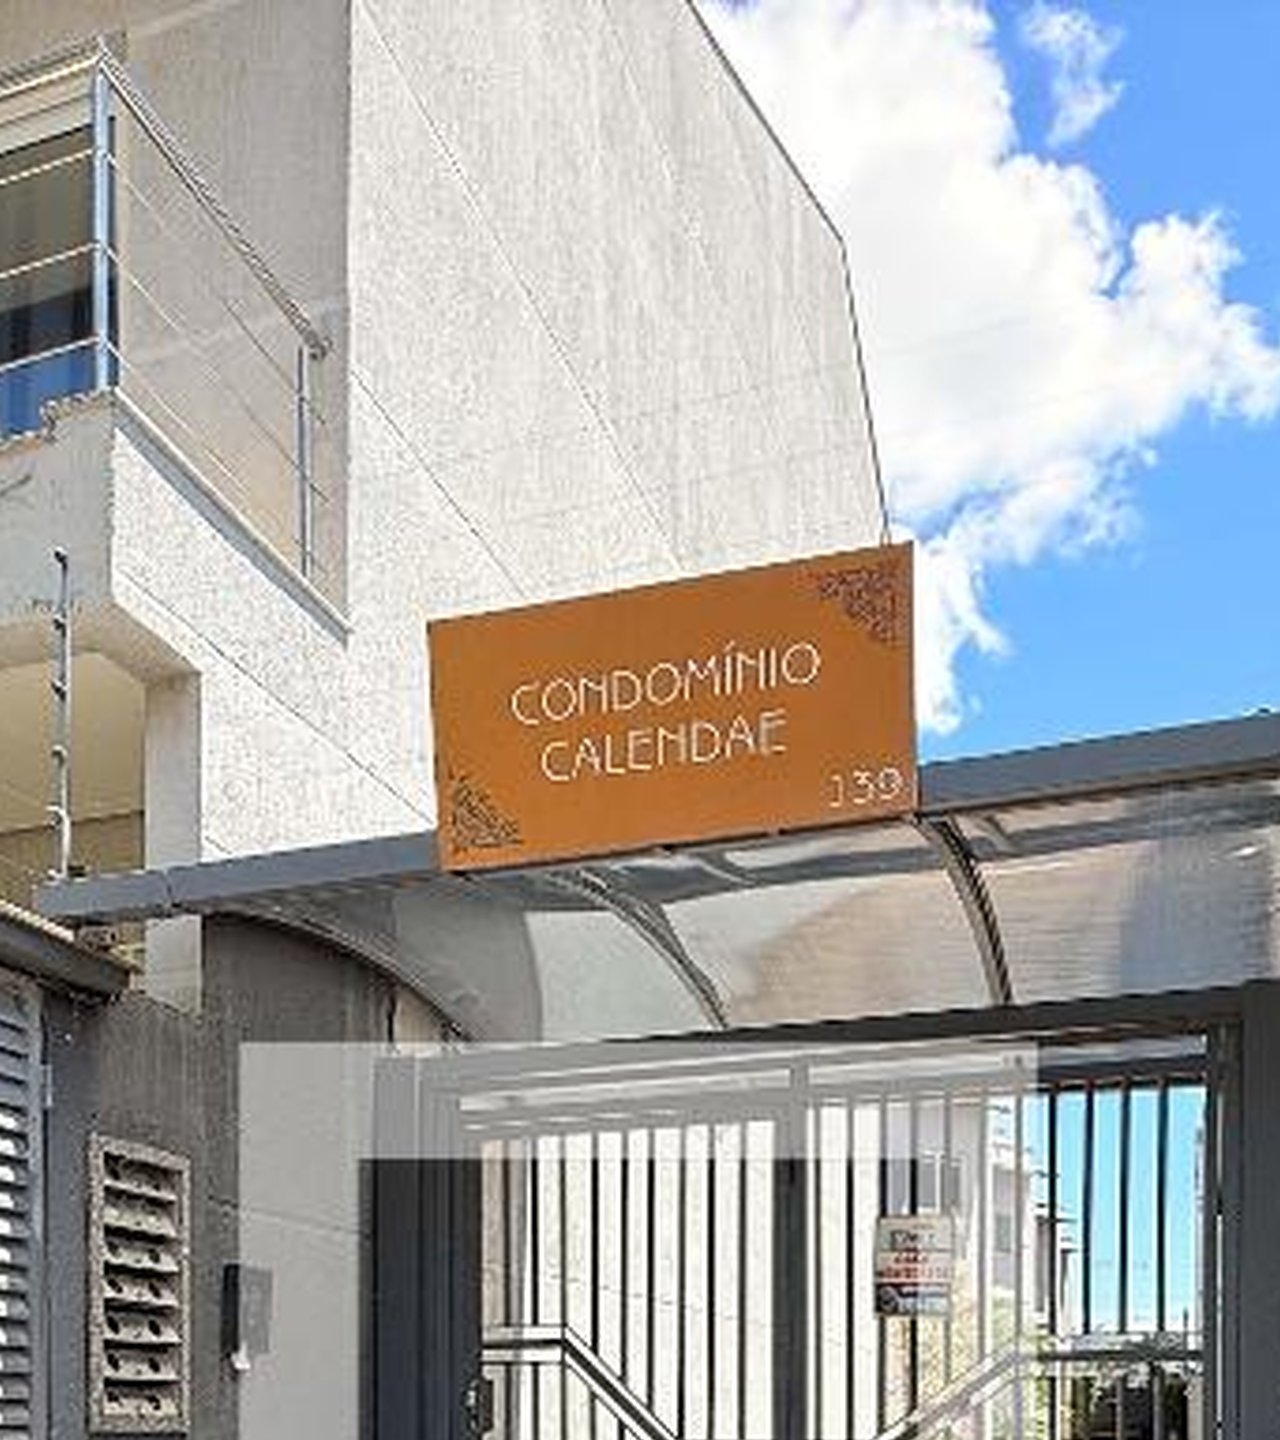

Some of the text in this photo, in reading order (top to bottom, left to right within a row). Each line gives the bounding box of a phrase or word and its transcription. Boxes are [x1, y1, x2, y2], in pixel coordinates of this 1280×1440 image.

[511, 640, 821, 726] CONDOMÍNIO
[541, 710, 788, 782] CALENDAE
[829, 766, 904, 807] 139
